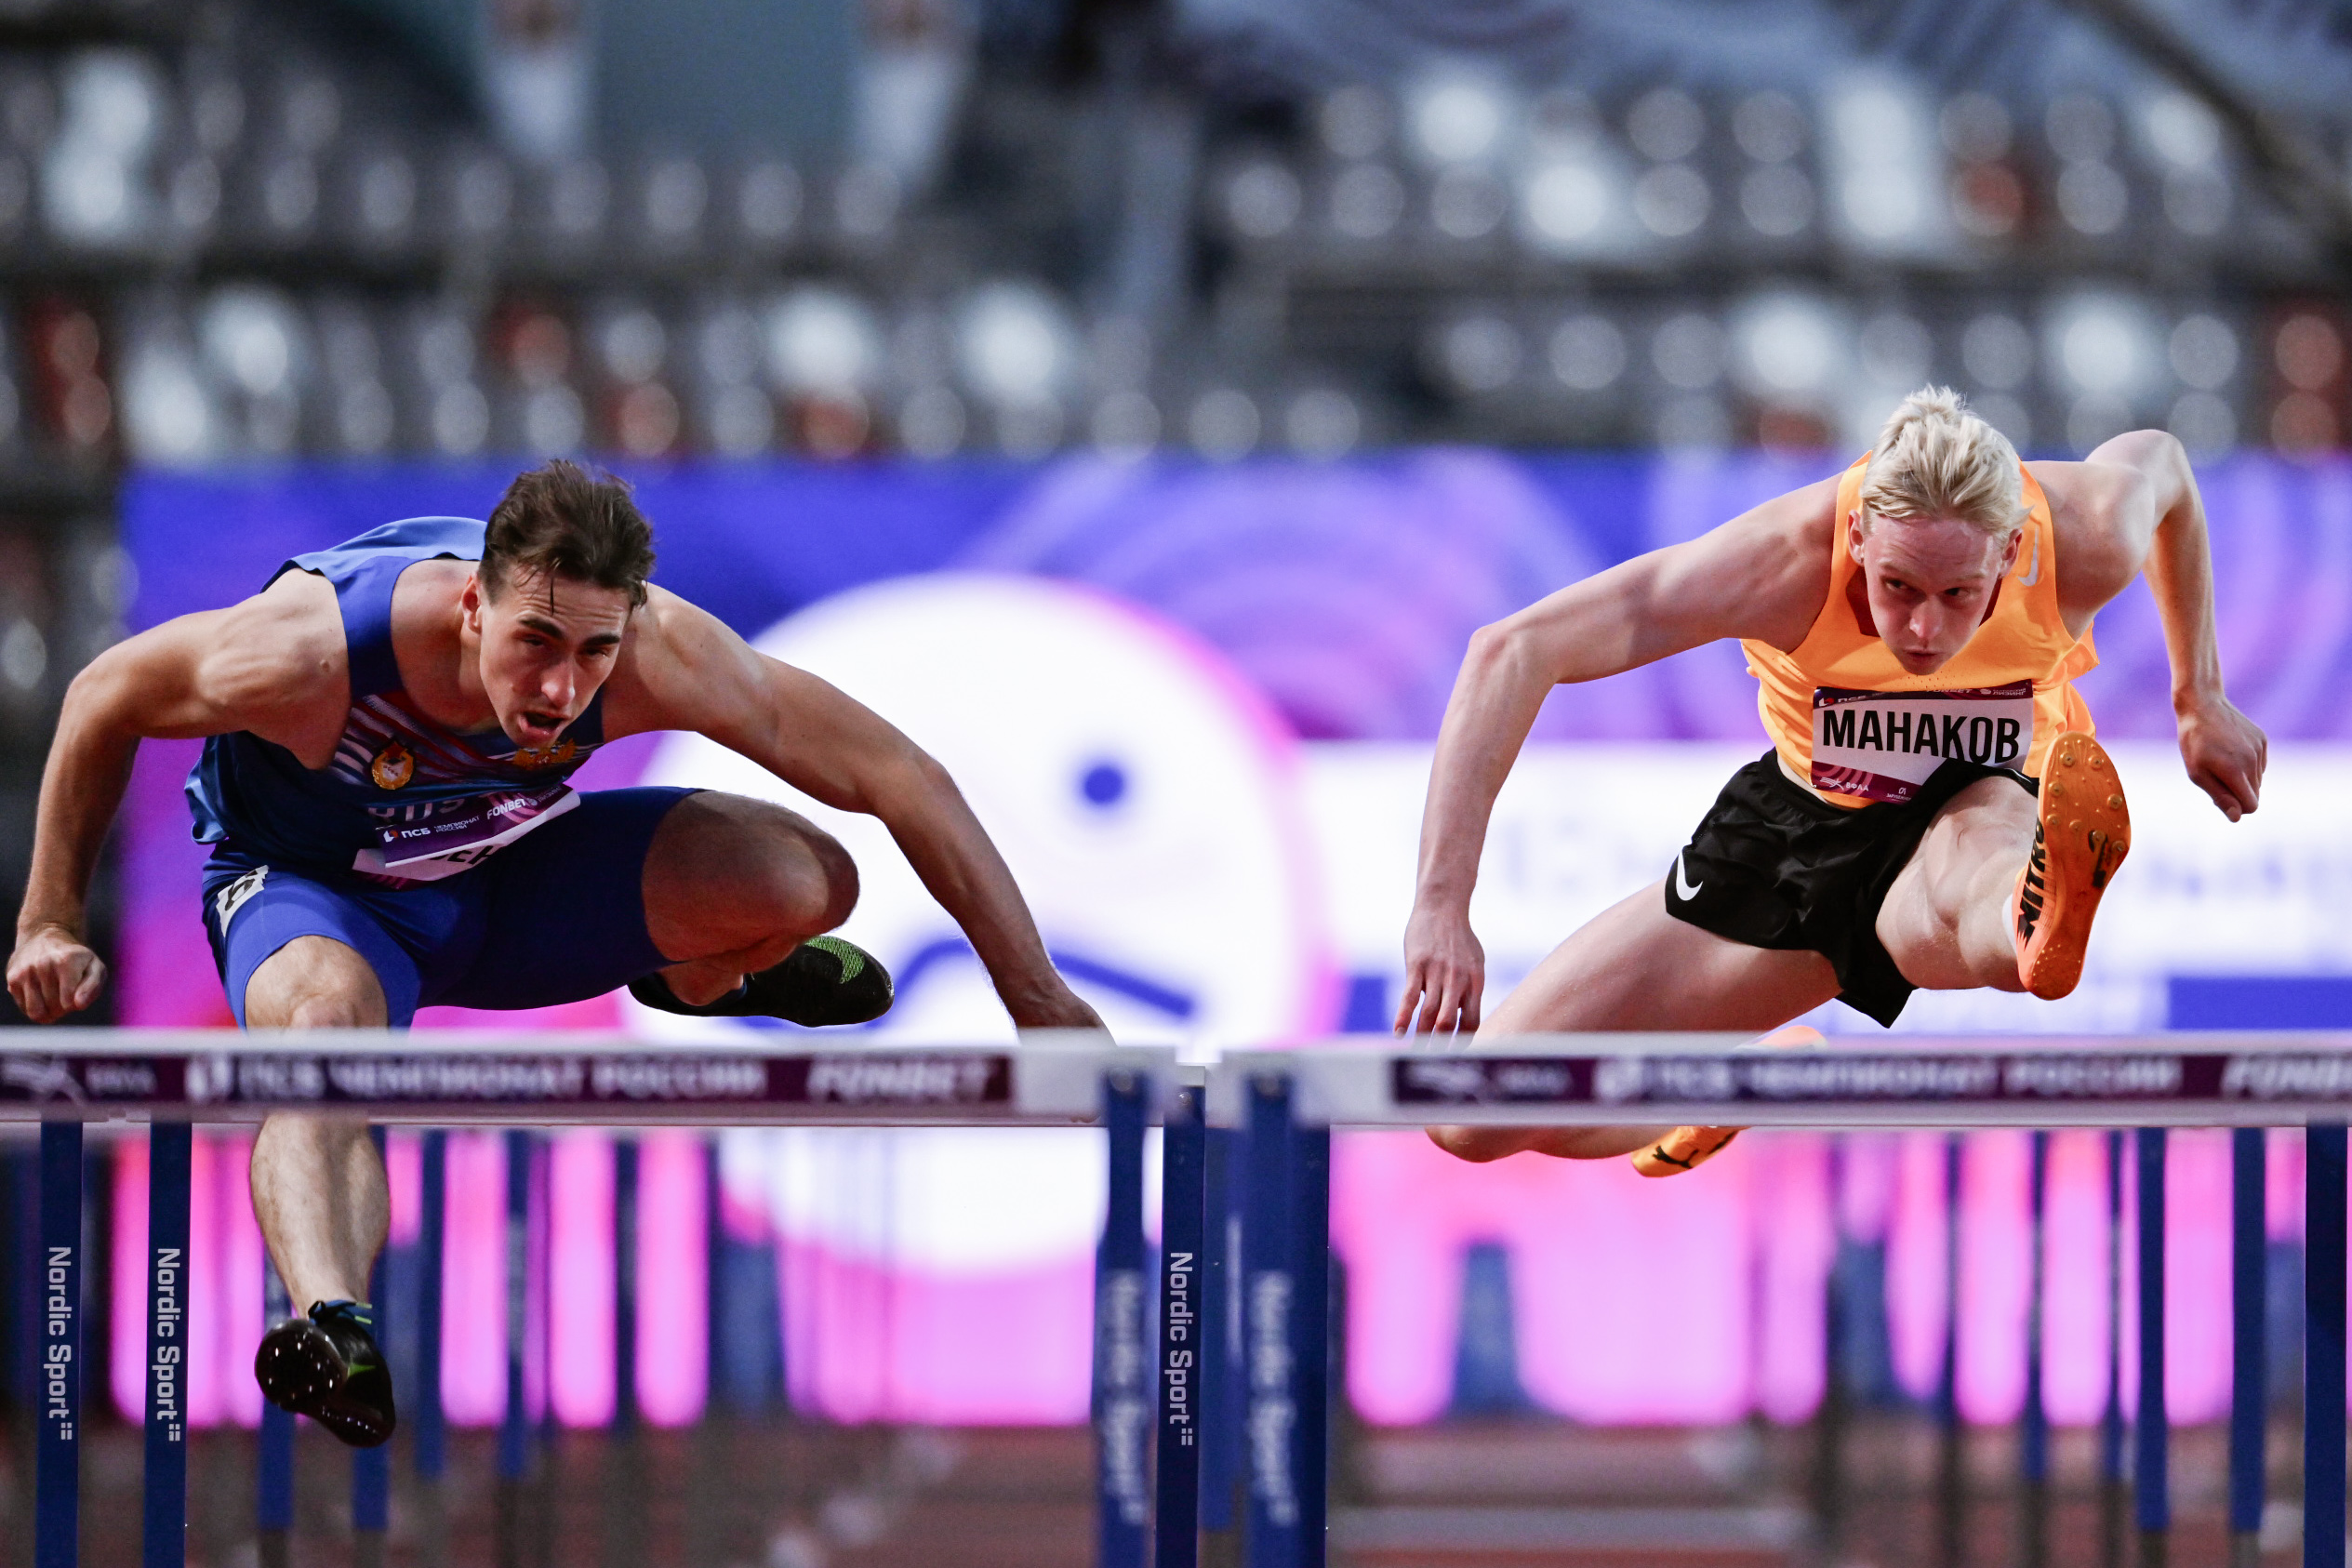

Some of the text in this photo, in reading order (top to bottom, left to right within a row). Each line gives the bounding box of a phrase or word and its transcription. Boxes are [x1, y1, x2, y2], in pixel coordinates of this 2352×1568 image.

[1823, 710, 2020, 764] МАНАКОВ
[486, 798, 526, 819] FONBET
[1845, 781, 1869, 791] ВФЛА
[401, 828, 431, 839] ПСБ
[43, 1246, 72, 1419] Nordic Sport
[152, 1248, 180, 1420] Nordic Sport
[1164, 1252, 1193, 1424] Nordic Sport
